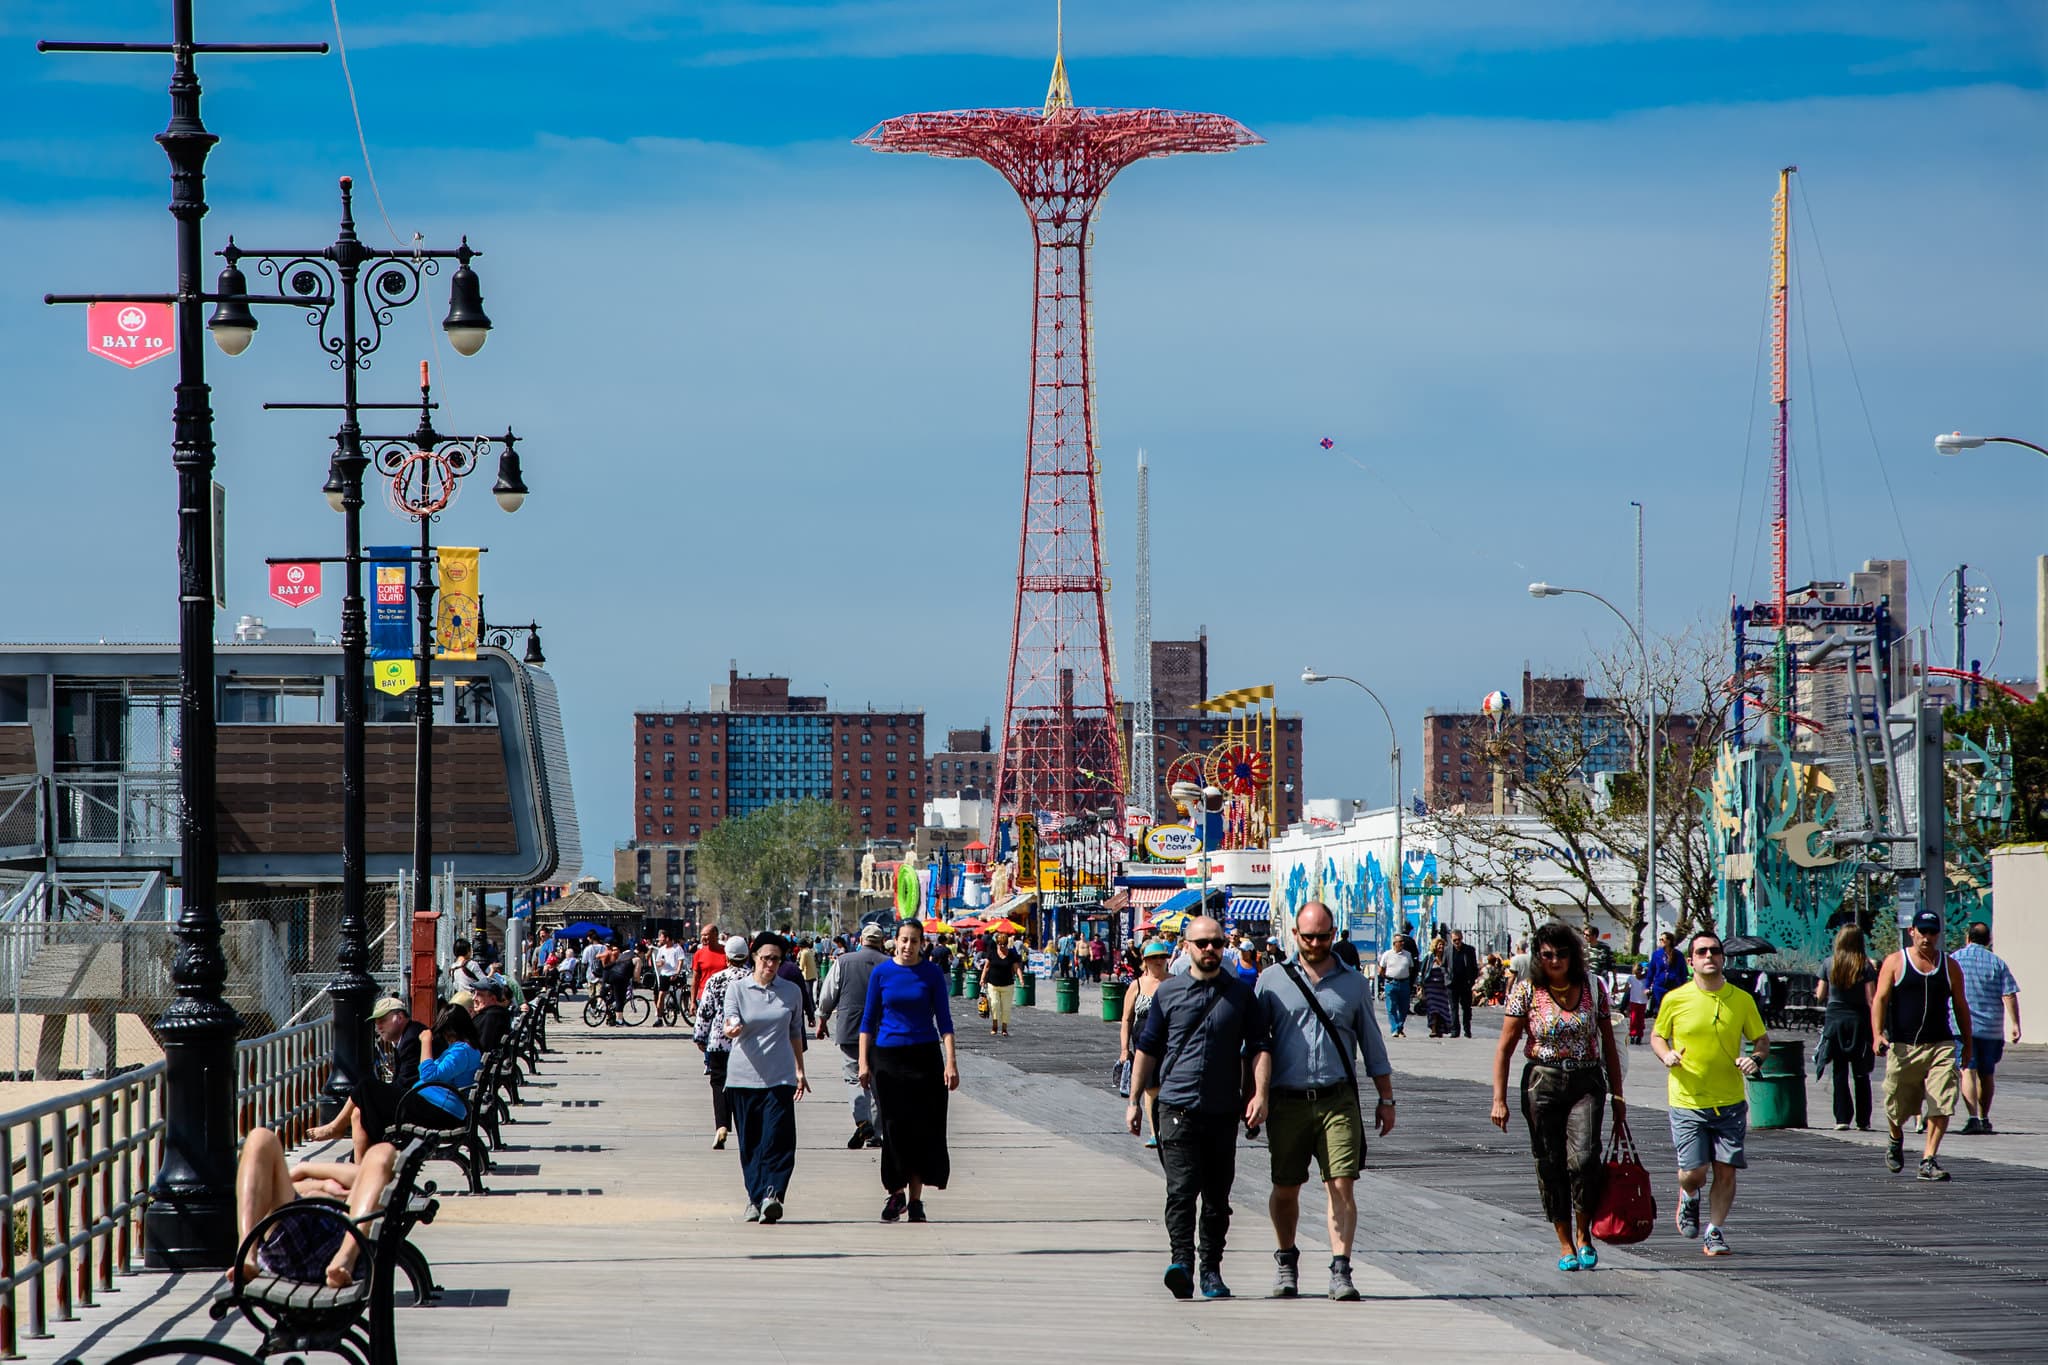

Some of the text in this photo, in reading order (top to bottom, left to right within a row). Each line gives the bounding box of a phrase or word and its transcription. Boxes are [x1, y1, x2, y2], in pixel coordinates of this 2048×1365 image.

[102, 335, 163, 348] BAY 10
[278, 585, 315, 595] BAY 10
[378, 593, 404, 602] ISLAND
[1822, 606, 1875, 622] EAGLE
[382, 679, 396, 688] BAY
[1166, 843, 1192, 851] cones
[1152, 867, 1182, 875] ITALIAN
